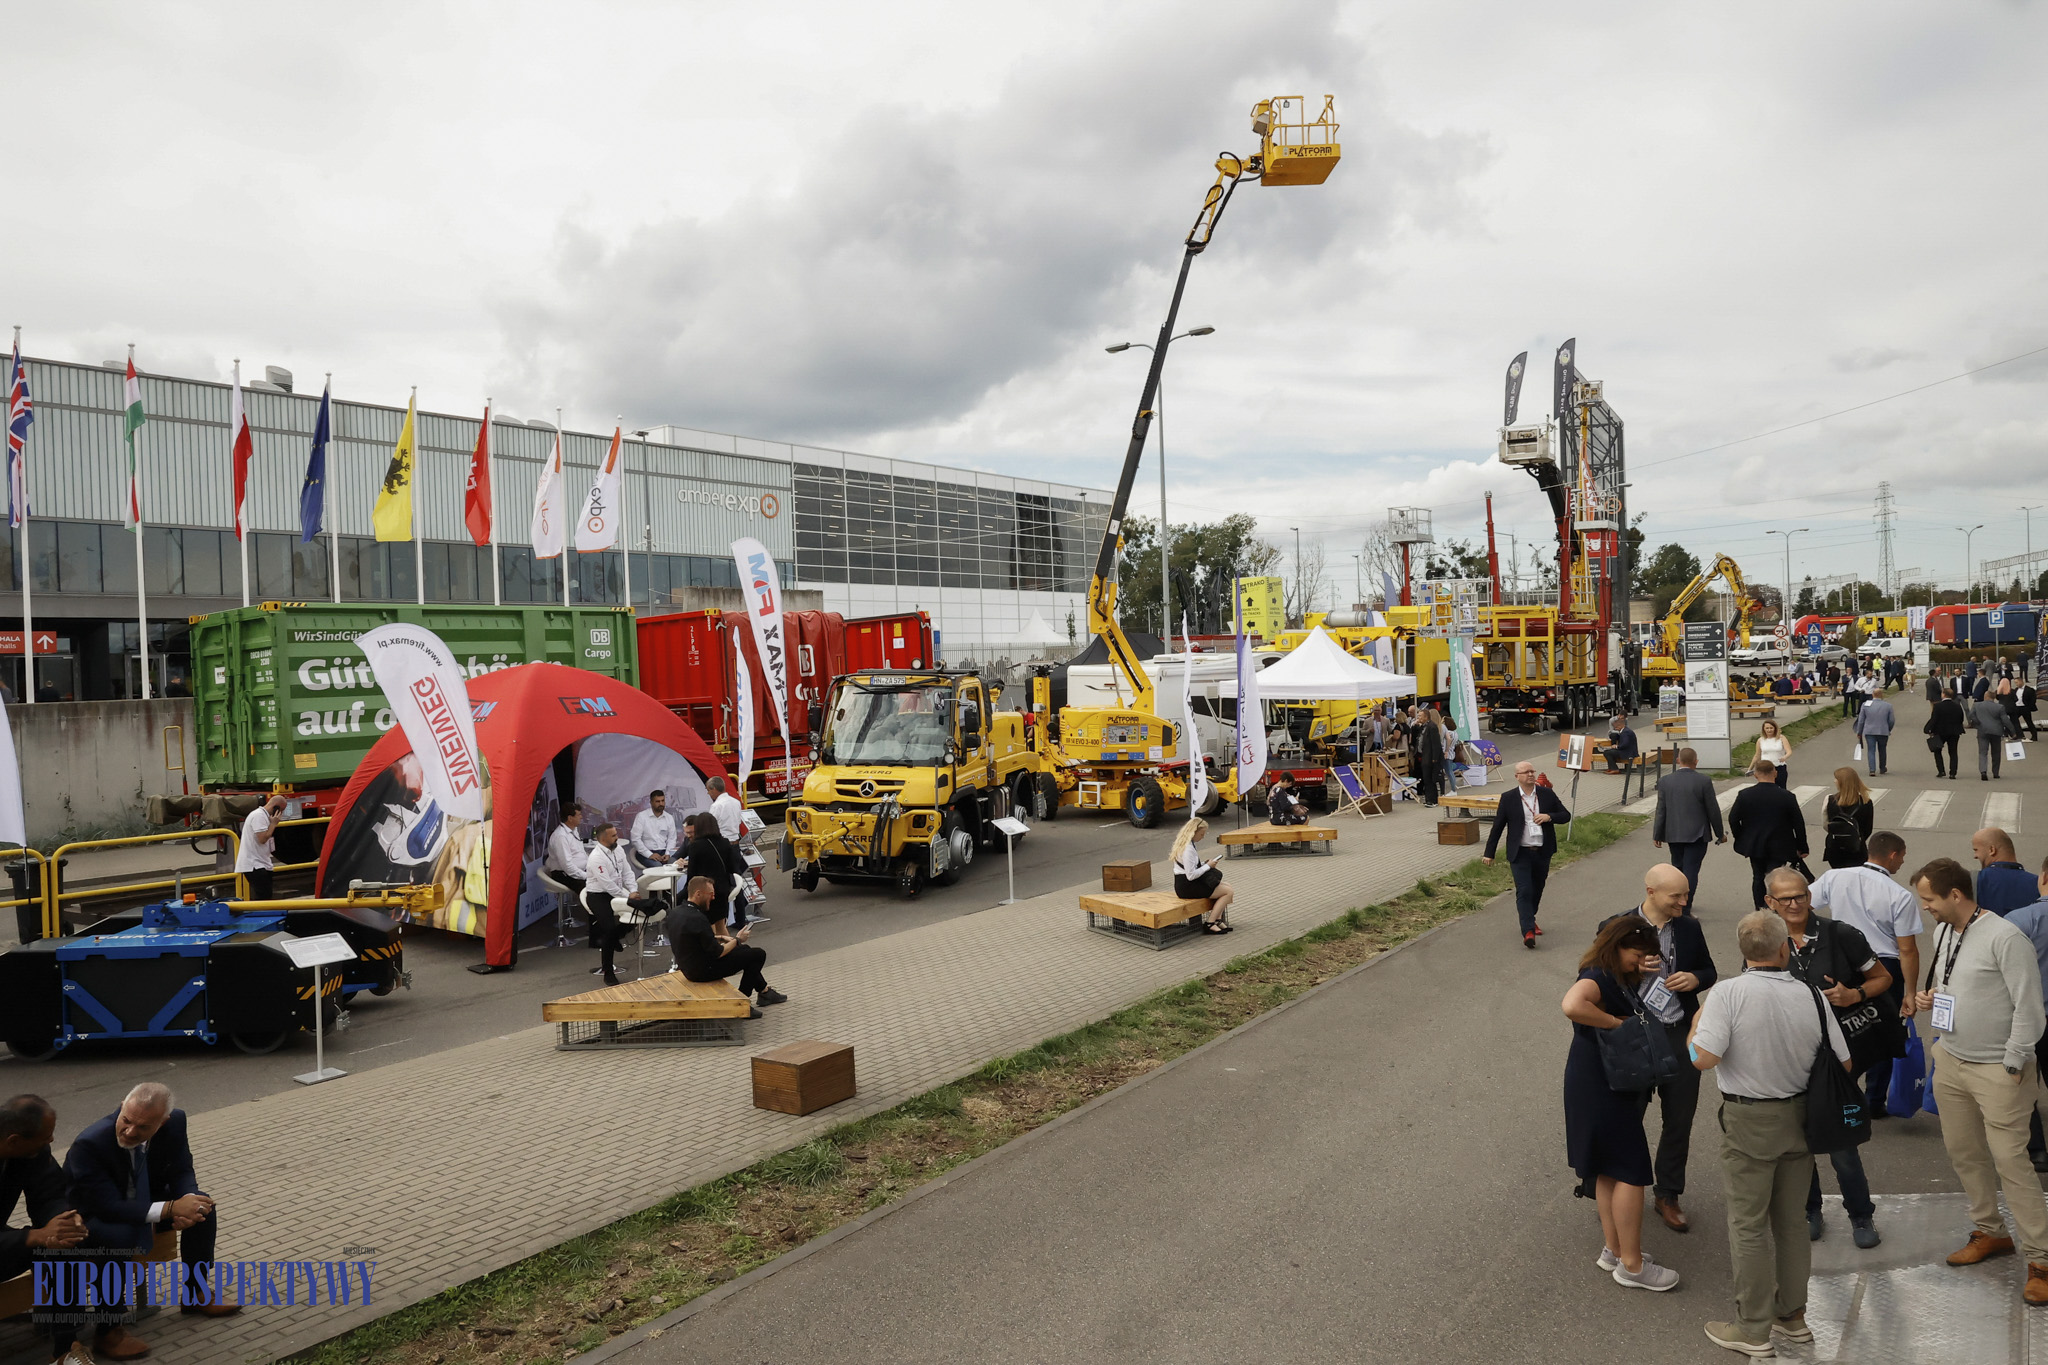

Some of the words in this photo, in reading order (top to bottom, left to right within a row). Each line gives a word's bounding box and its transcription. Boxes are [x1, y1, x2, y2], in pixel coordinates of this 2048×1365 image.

[1289, 146, 1332, 156] PLATFORM
[1246, 579, 1265, 588] TRAKO
[1991, 612, 2001, 624] P
[592, 631, 609, 643] DB
[1810, 635, 1819, 646] P
[584, 648, 611, 660] Cargo
[297, 701, 366, 736] auf
[525, 893, 549, 918] ZAGRO
[1841, 1006, 1878, 1032] TRAO
